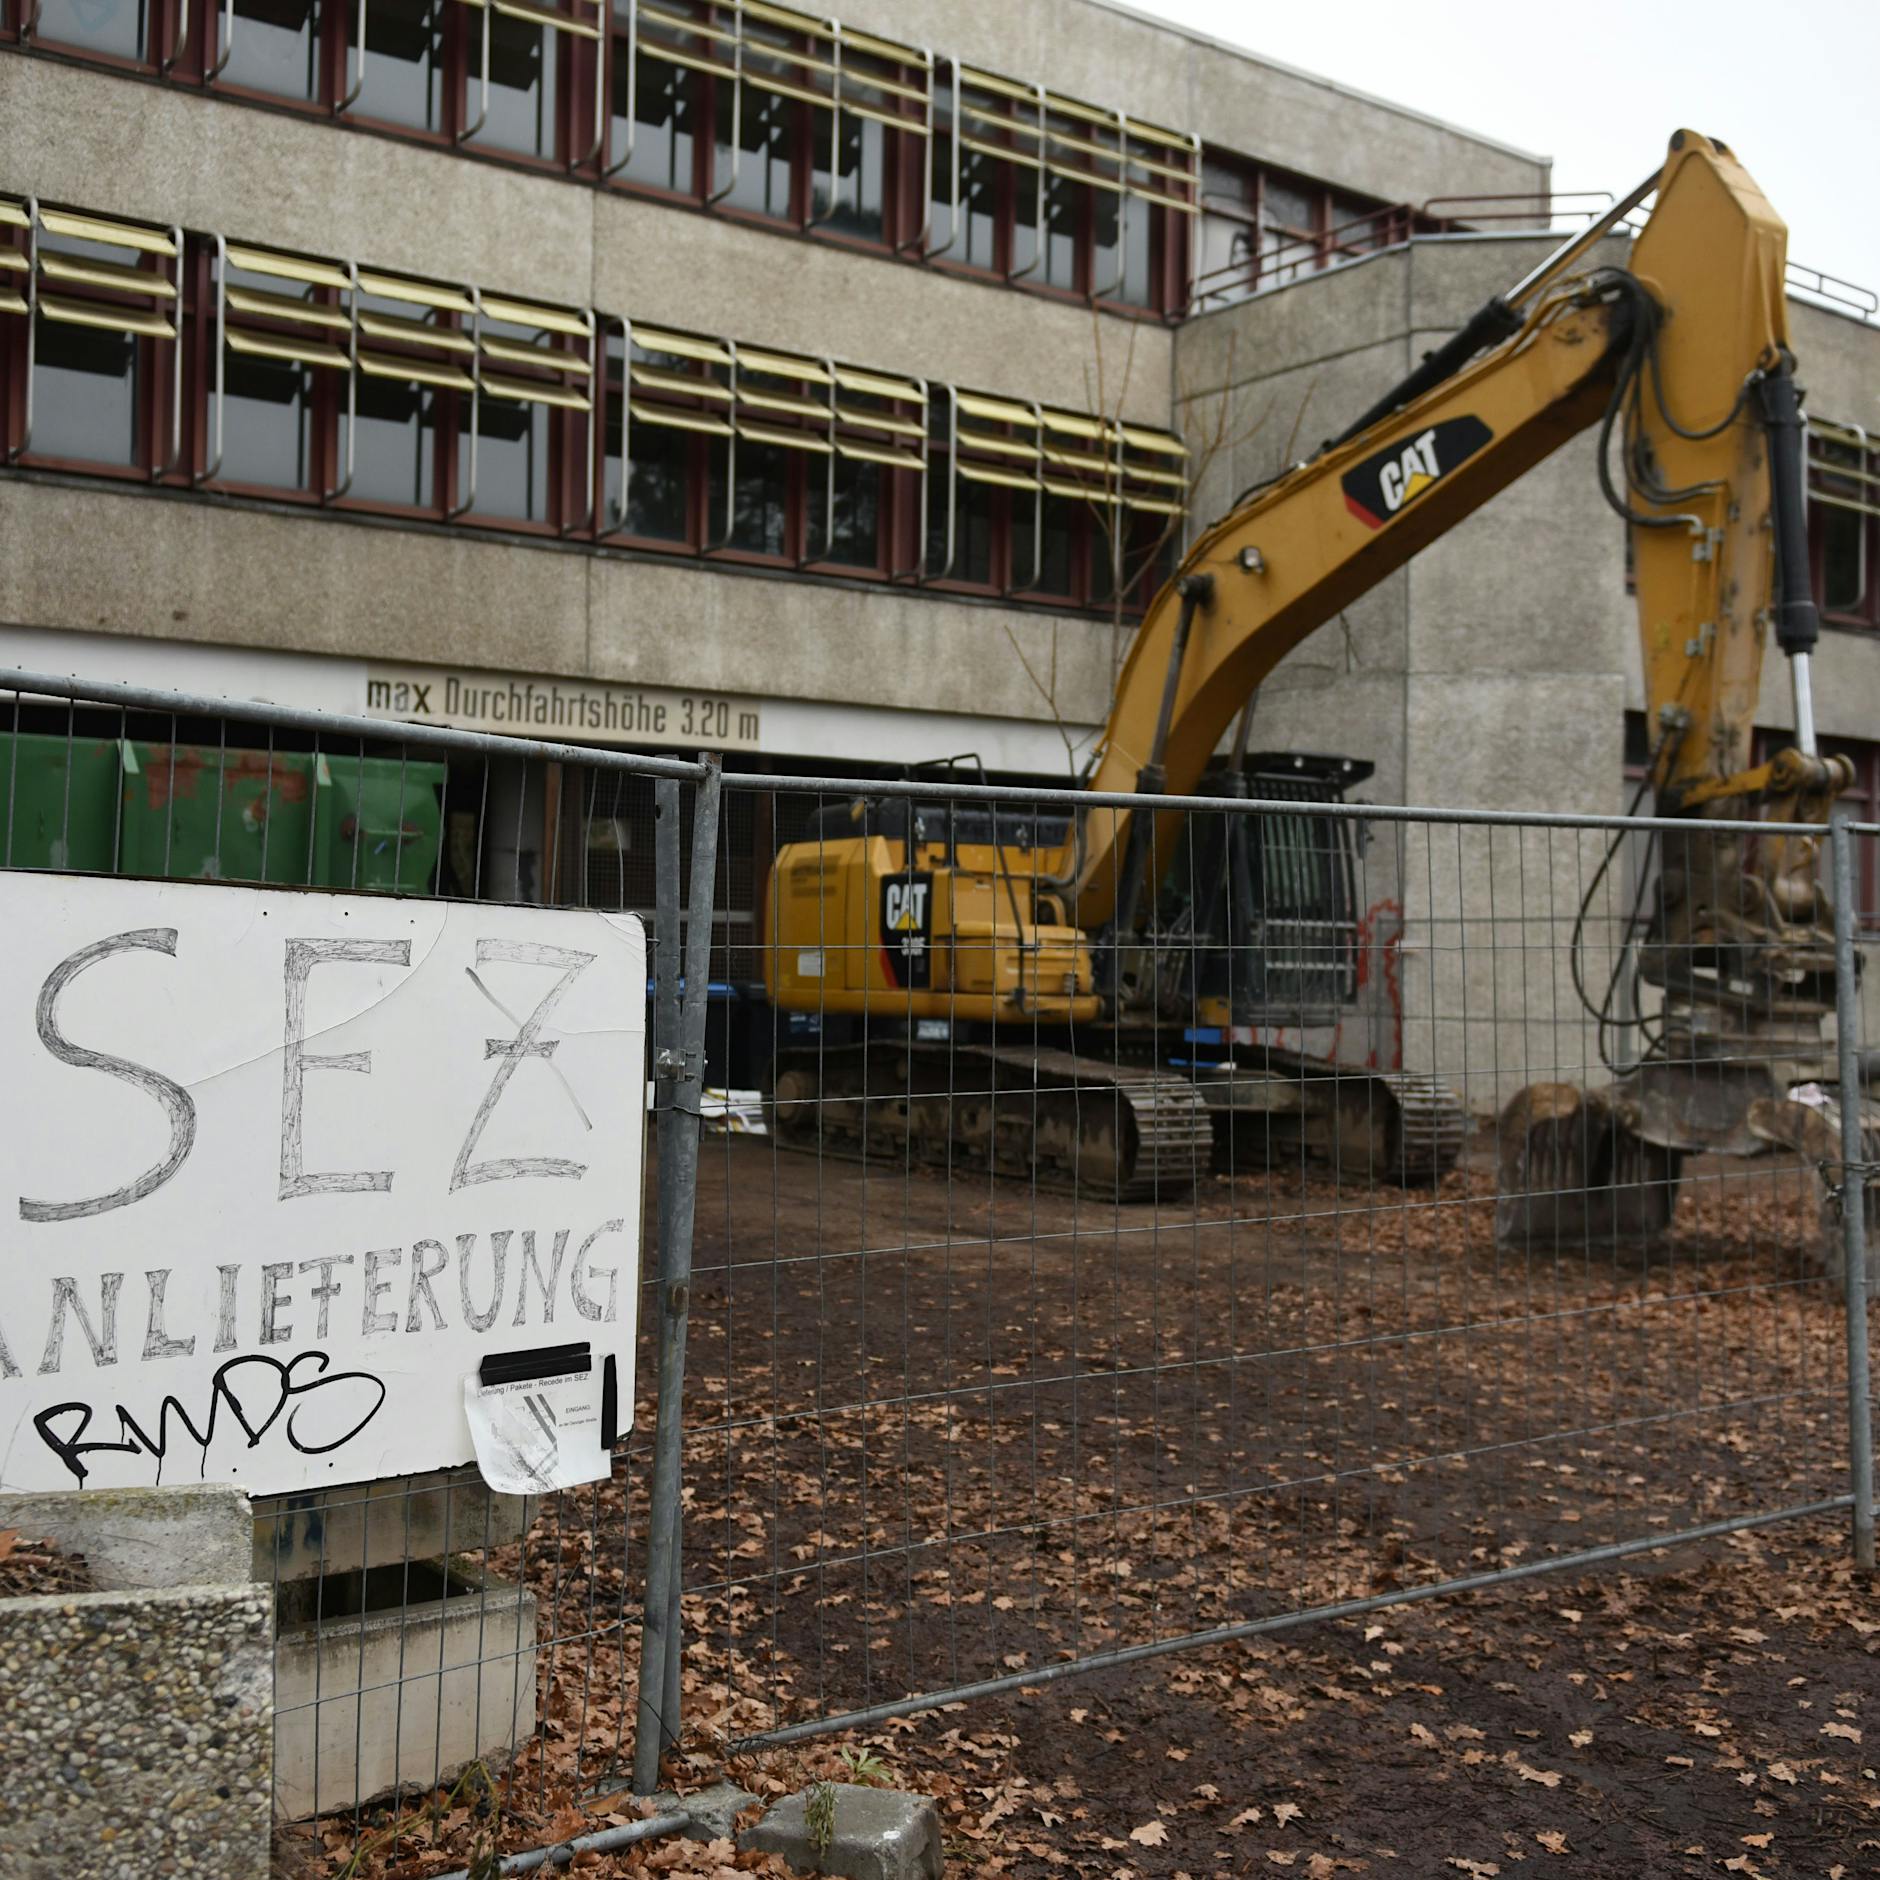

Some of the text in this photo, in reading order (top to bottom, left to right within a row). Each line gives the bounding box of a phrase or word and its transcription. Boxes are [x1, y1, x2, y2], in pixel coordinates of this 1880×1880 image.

[1379, 429, 1441, 511] CAT
[367, 677, 760, 741] max Durchfahrtshöhe 3.20 m
[886, 883, 927, 931] CAT
[510, 1383, 533, 1391] Pakete
[574, 1373, 589, 1381] SEZ
